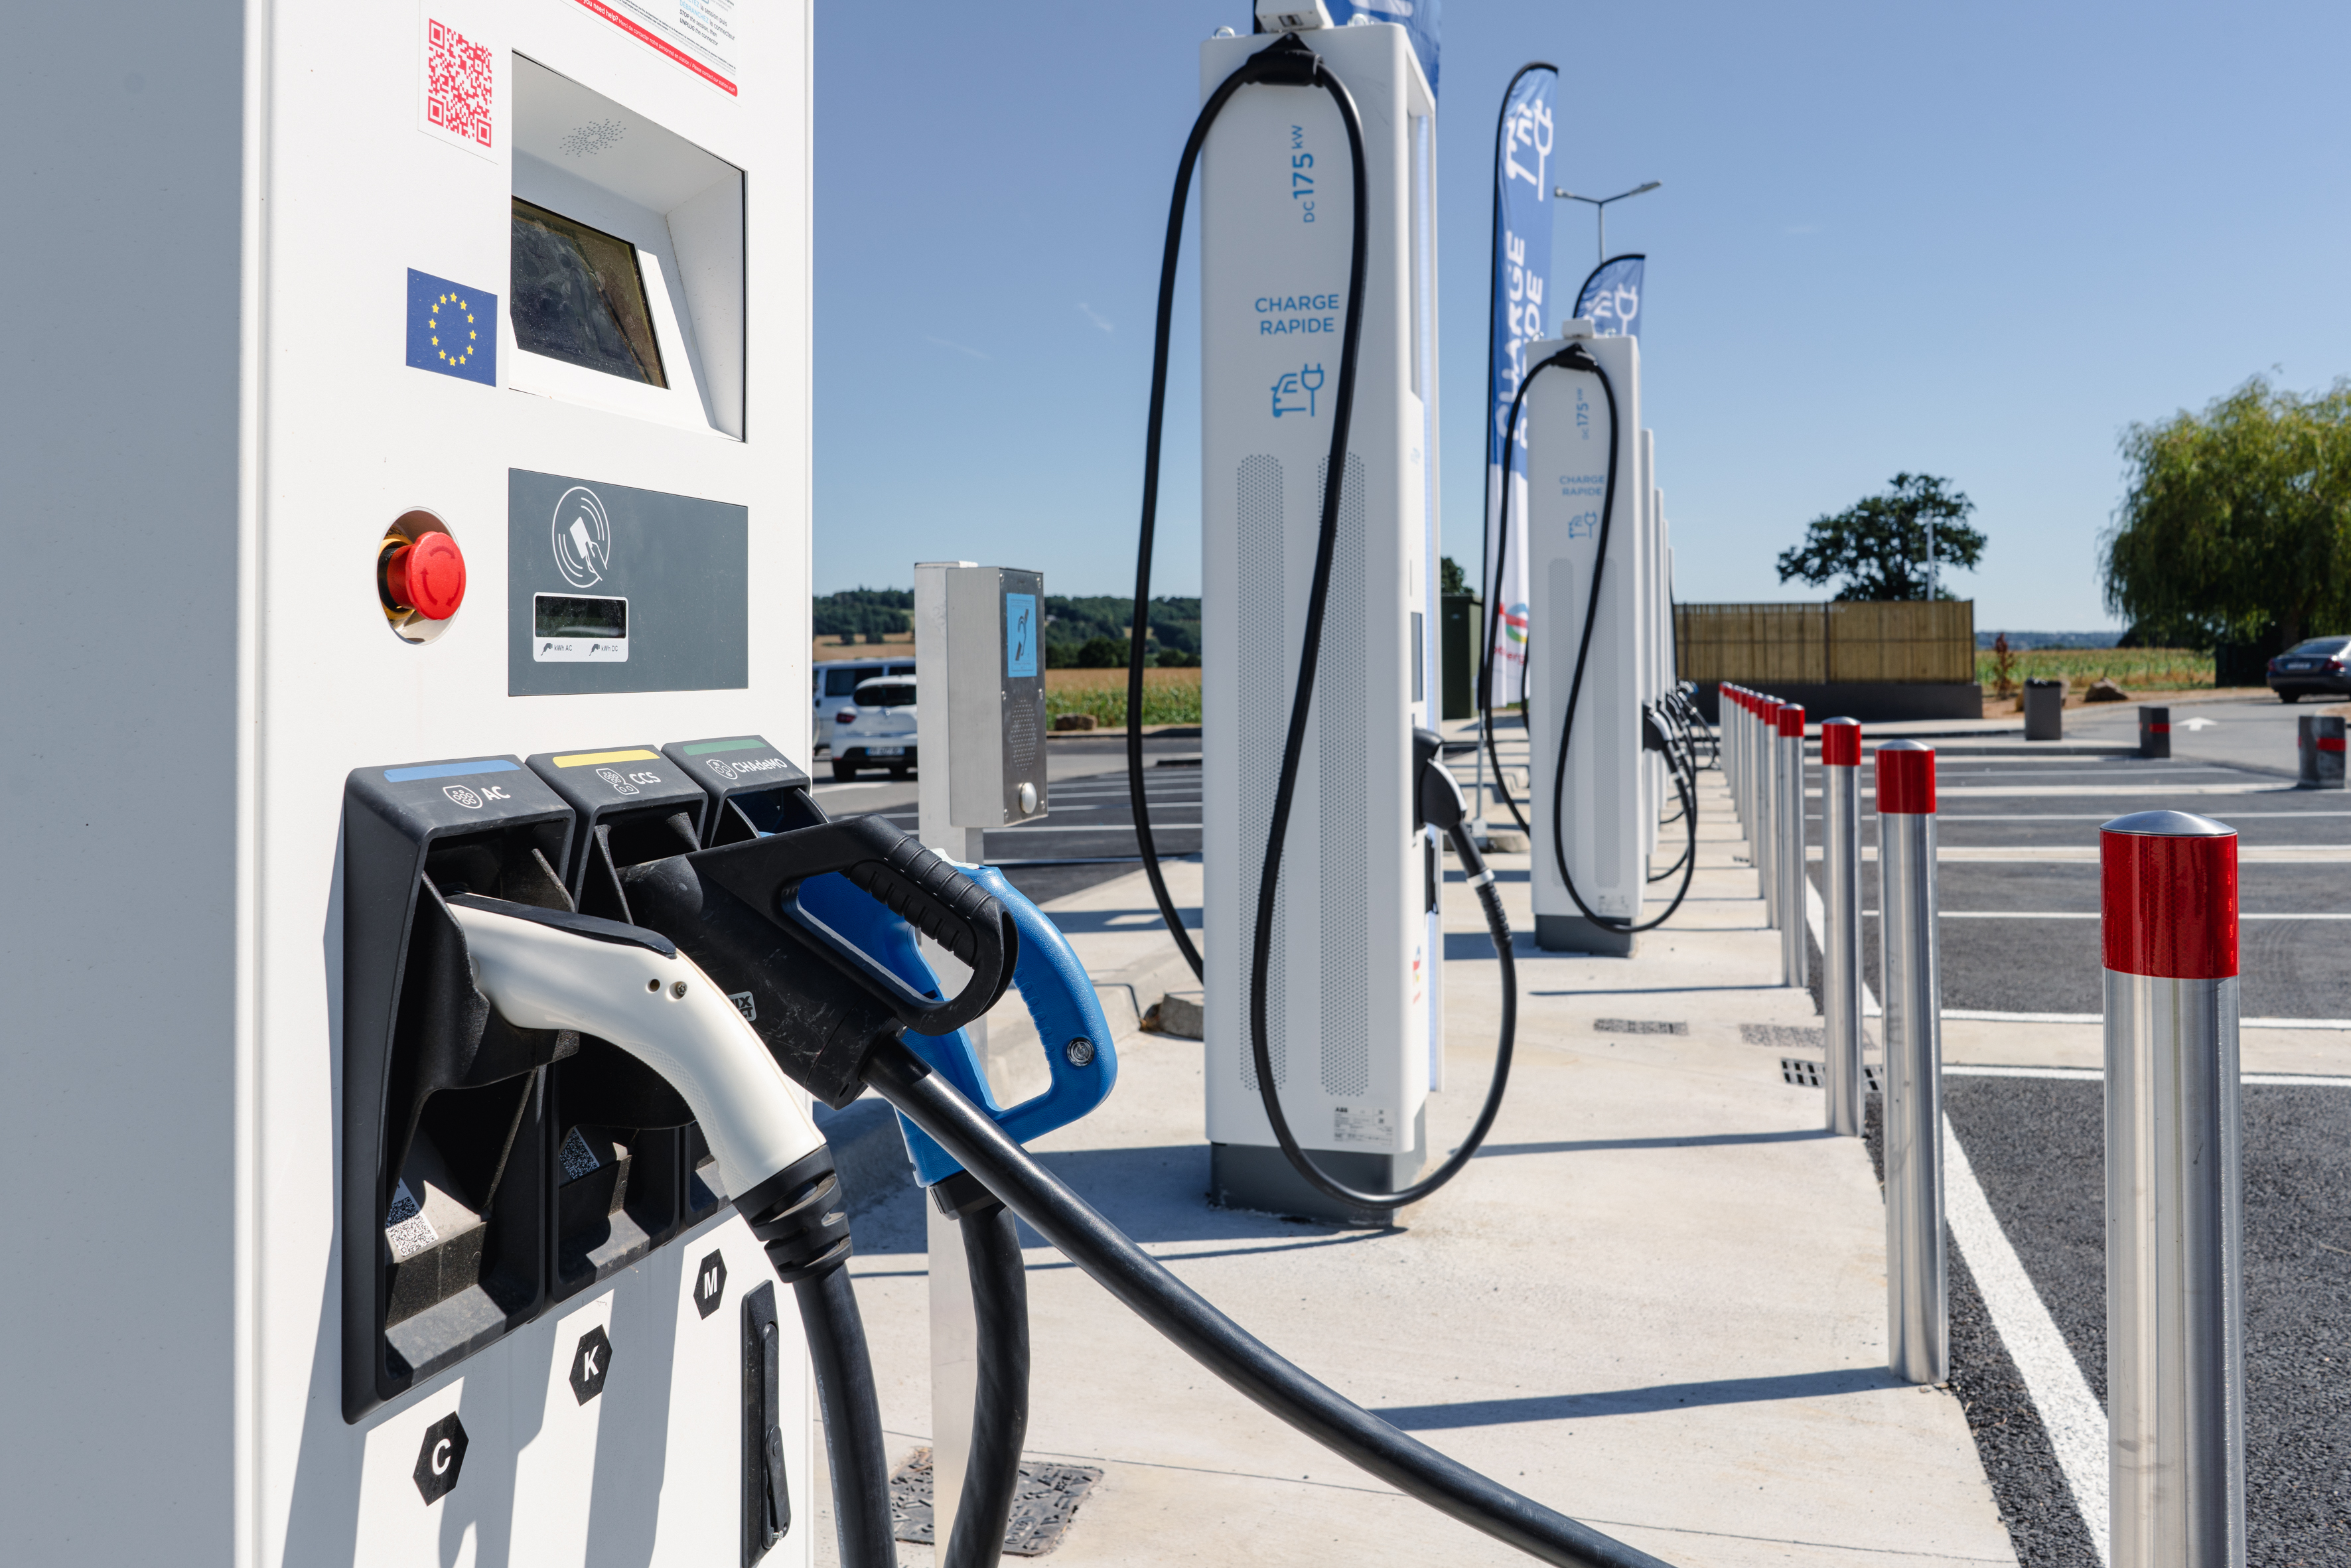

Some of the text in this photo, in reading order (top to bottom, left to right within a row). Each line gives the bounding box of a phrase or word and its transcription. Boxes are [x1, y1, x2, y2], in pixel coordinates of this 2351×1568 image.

[679, 9, 689, 18] STOP
[679, 0, 709, 24] DÉBRANCHEZ
[713, 23, 735, 40] connecteur
[705, 7, 719, 21] session
[679, 17, 695, 31] UNPLUG
[701, 33, 718, 46] connector
[593, 3, 605, 15] need
[606, 9, 618, 22] help?
[618, 19, 628, 28] Merci
[633, 29, 650, 41] contacter
[650, 38, 658, 47] notre
[658, 44, 675, 56] personnel
[679, 56, 689, 66] station
[692, 63, 701, 73] Please
[702, 70, 713, 80] contact
[719, 80, 728, 88] station
[1291, 125, 1315, 222] DC 175 kW
[1255, 294, 1339, 313] CHARGE
[1261, 317, 1334, 334] RAPIDE
[1576, 402, 1589, 427] 175
[1559, 474, 1604, 485] CHARGE
[1562, 486, 1603, 496] RAPIDE
[731, 756, 788, 774] CHAdeMO
[628, 771, 661, 787] CCS
[480, 786, 512, 802] AC
[704, 1267, 717, 1300] M
[584, 1345, 599, 1382] K
[431, 1438, 451, 1475] C
